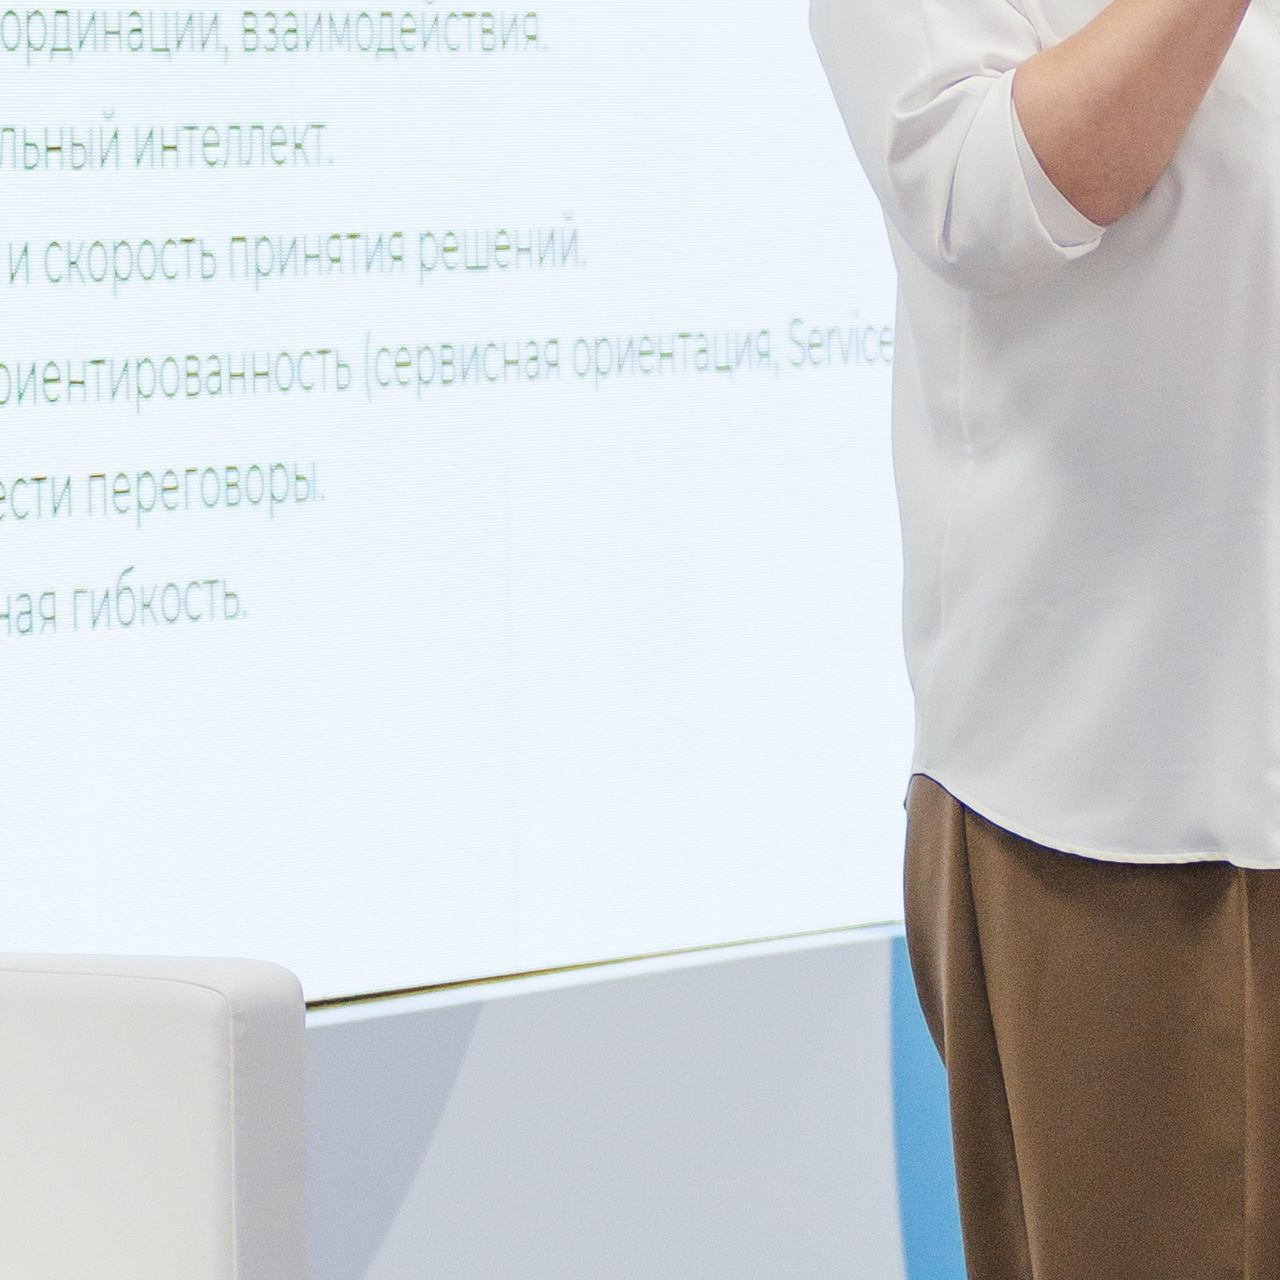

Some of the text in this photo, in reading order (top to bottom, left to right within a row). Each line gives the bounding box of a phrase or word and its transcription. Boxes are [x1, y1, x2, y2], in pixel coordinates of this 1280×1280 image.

[1, 9, 228, 69] ординации,
[1, 110, 334, 170] льный интеллект.
[9, 212, 586, 298] и скорость принятия решений.
[366, 330, 559, 403] (сервисная
[573, 328, 778, 392] ориентация,
[789, 310, 894, 367] Service
[90, 461, 324, 528] переговоры.
[74, 565, 247, 631] гибкость.
